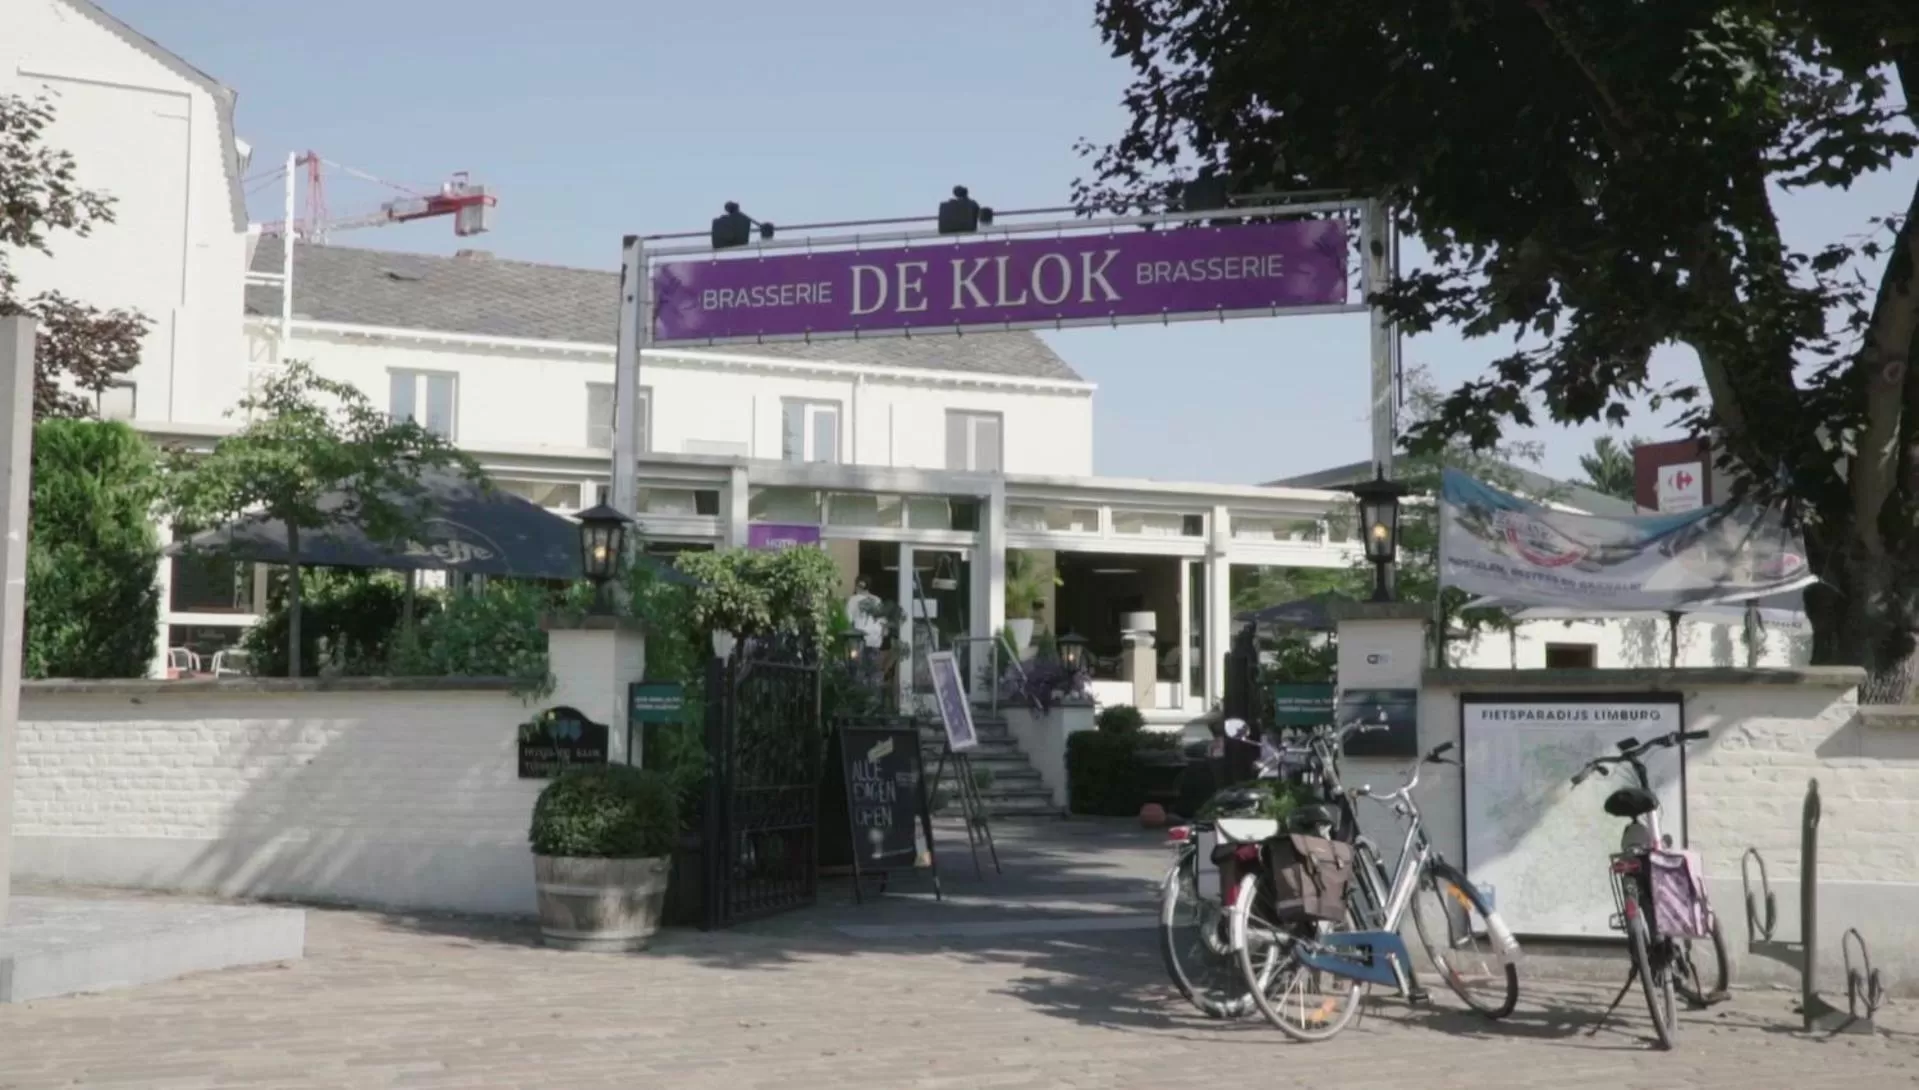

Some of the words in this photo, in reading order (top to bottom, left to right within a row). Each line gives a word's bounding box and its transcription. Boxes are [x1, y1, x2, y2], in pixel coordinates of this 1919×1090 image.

[702, 282, 833, 310] BRASSERIE
[848, 260, 928, 316] DE
[949, 249, 1121, 311] KLOK
[1136, 254, 1284, 285] BRASSERIE
[1481, 709, 1589, 721] FIETSPARADIJS
[1594, 709, 1661, 721] LIMBURG
